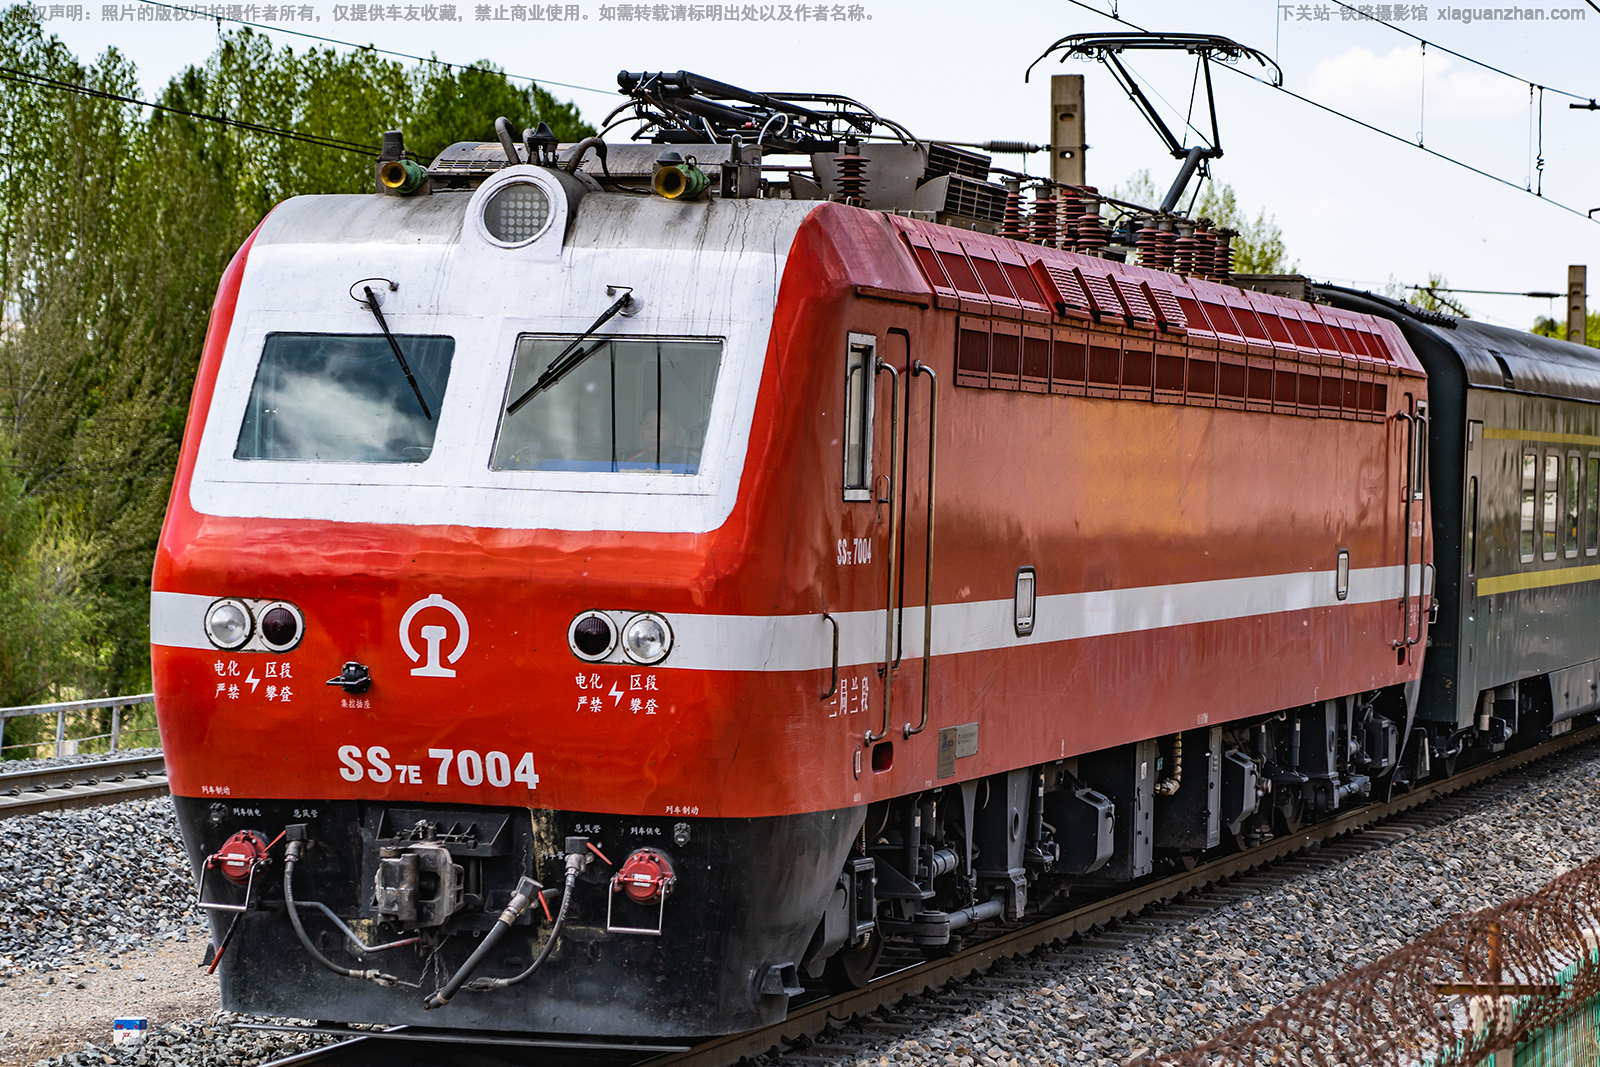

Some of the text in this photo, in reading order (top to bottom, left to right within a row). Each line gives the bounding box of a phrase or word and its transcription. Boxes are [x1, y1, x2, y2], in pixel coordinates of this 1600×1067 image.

[854, 537, 871, 565] 7004
[214, 660, 293, 679] 电化 区段
[575, 672, 658, 691] 电化 区段
[214, 683, 294, 702] 严禁 攀登
[576, 696, 658, 715] 严禁 攀登
[428, 748, 540, 790] 7004
[201, 785, 231, 796] 列车制动
[664, 805, 699, 816] 列车制动
[574, 823, 602, 834] 总风管
[630, 826, 662, 836] 列车供电
